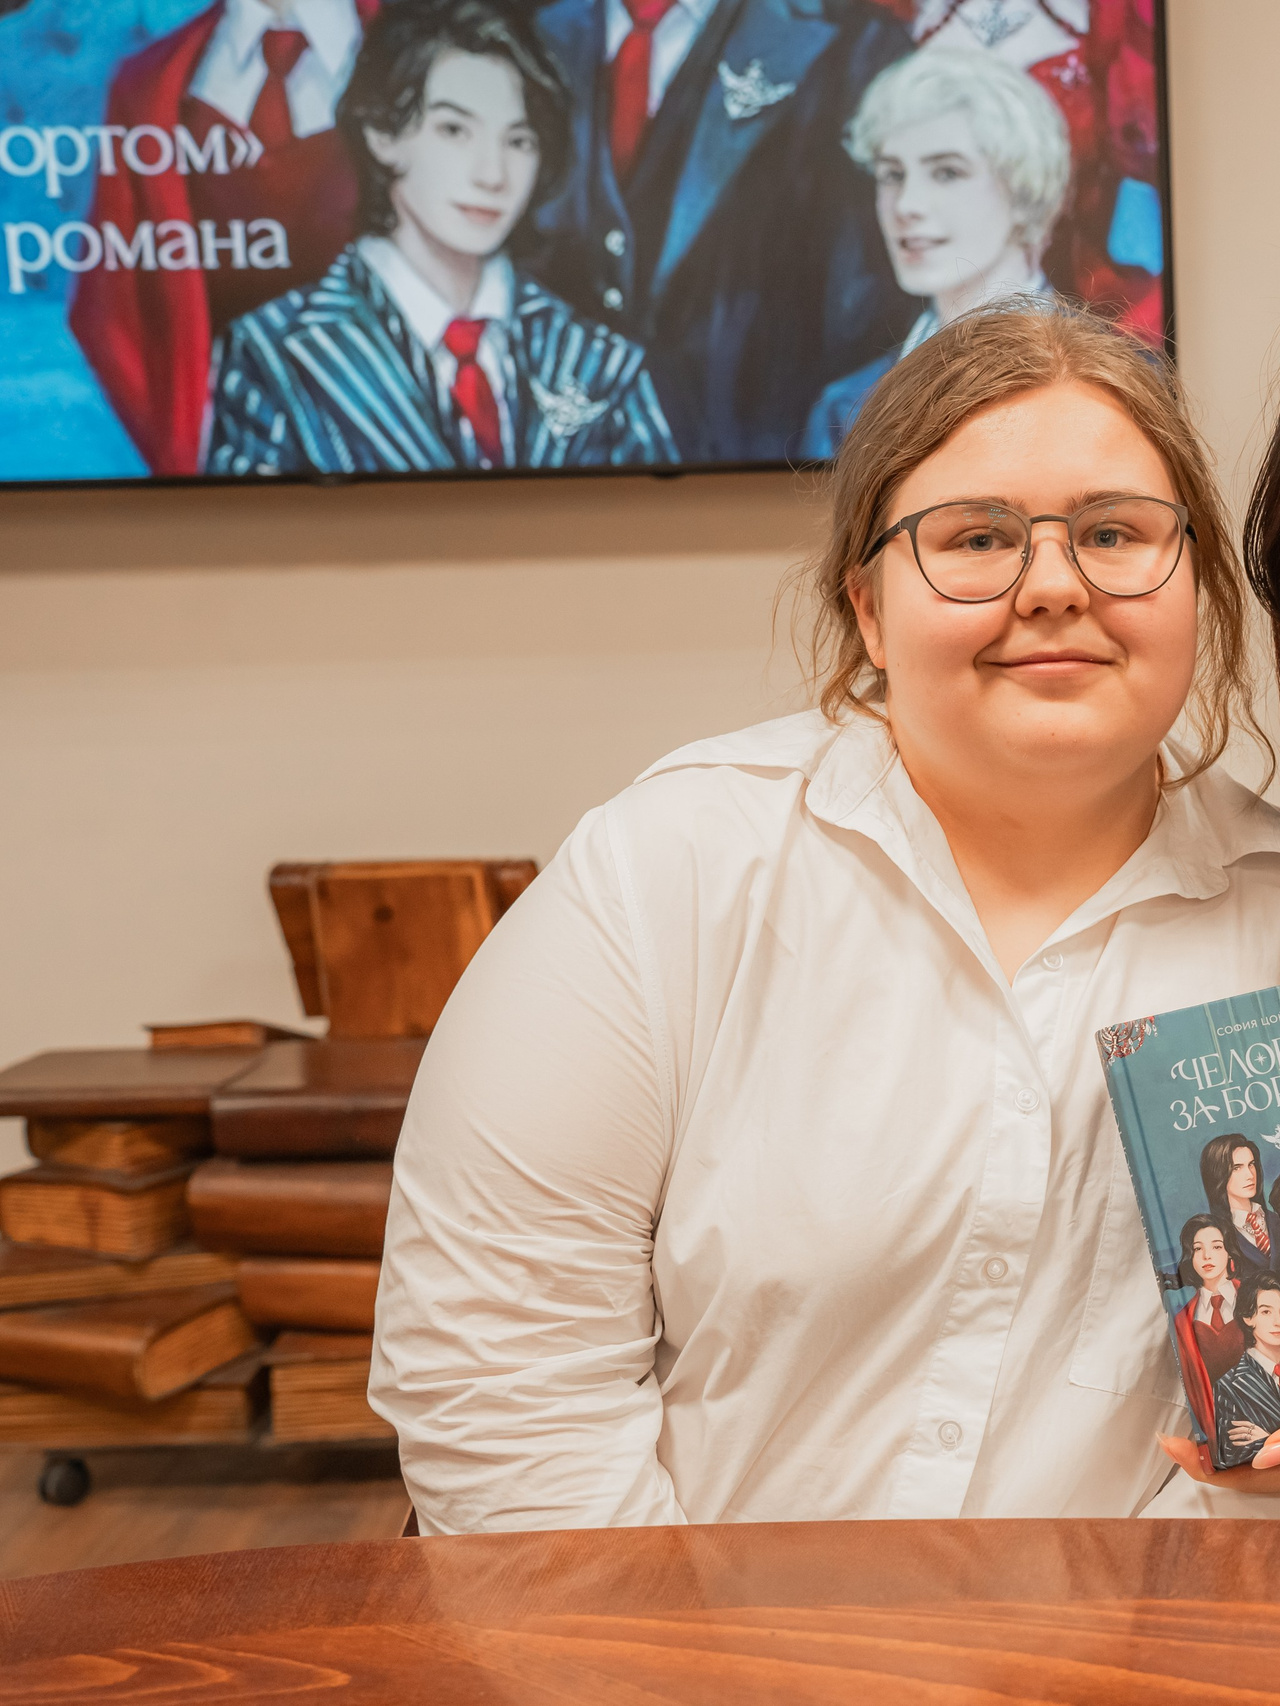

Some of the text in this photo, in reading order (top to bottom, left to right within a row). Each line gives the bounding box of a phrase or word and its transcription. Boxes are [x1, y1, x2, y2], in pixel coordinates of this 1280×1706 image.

[0, 124, 264, 198] ортом»
[4, 218, 291, 294] романа
[1216, 1019, 1258, 1037] СОФИЯ
[1169, 1096, 1221, 1132] ЗА
